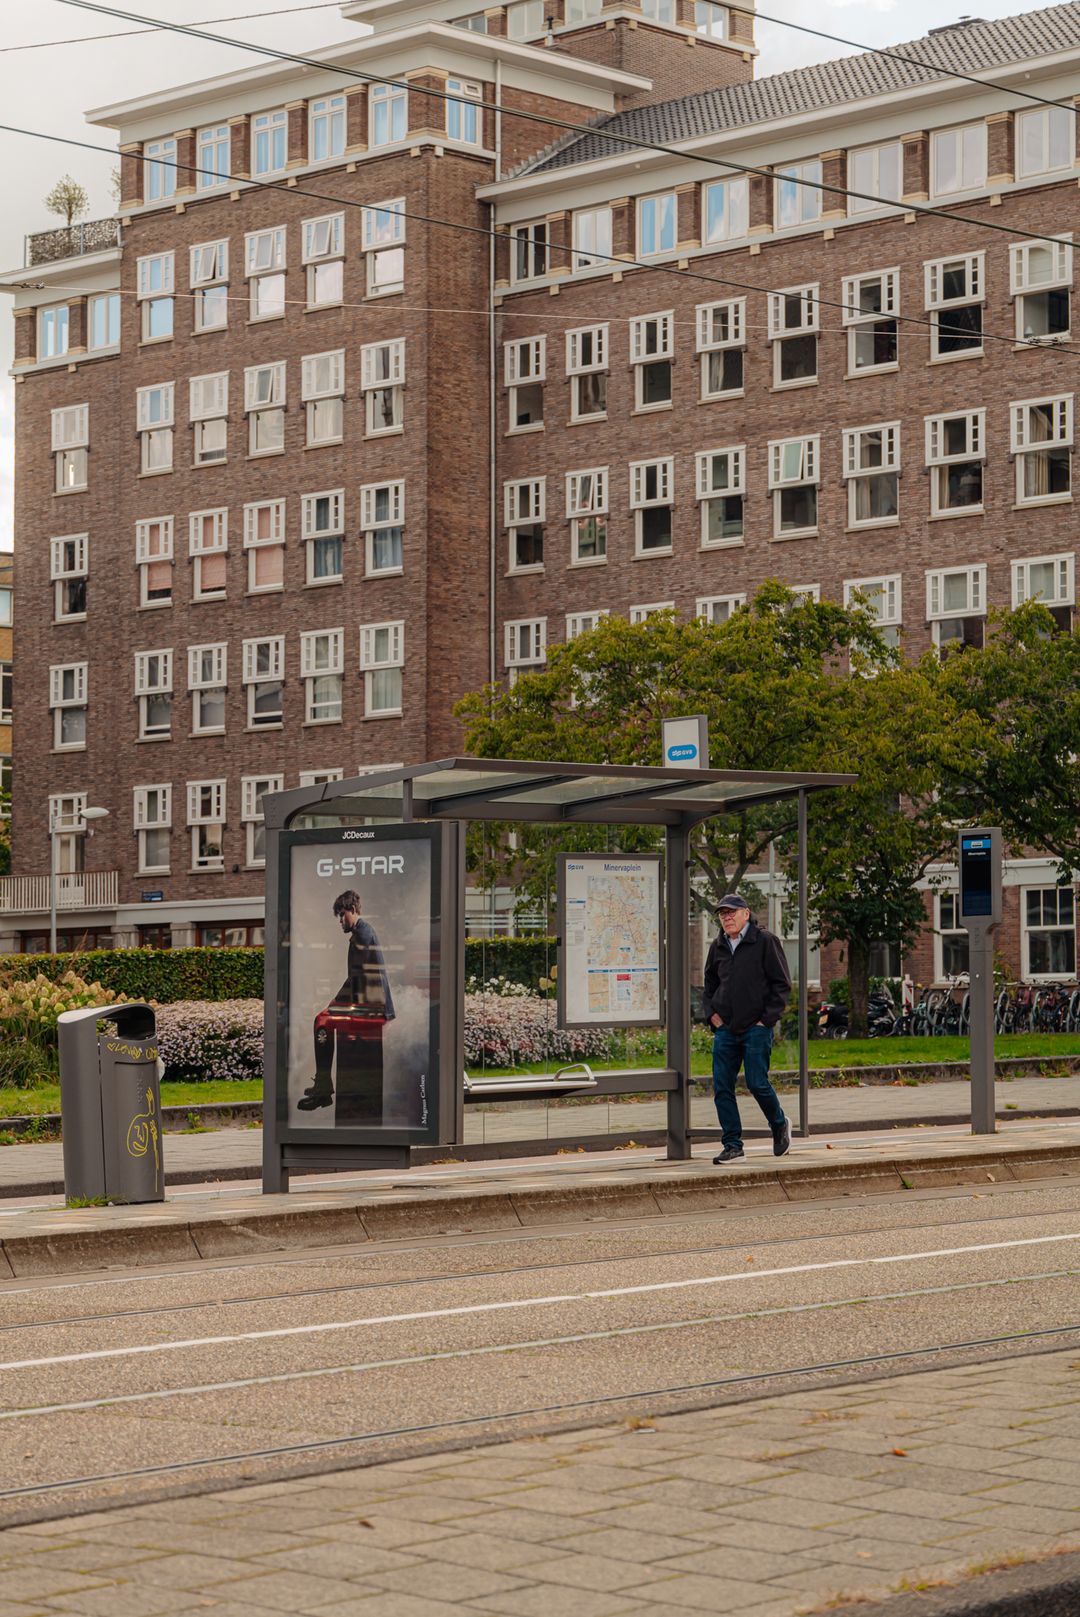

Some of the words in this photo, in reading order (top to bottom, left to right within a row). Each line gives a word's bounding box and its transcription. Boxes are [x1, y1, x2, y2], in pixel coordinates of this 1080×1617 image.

[342, 831, 375, 839] JCDecaux
[317, 855, 404, 877] G-STAR
[603, 864, 641, 872] Minervaplein
